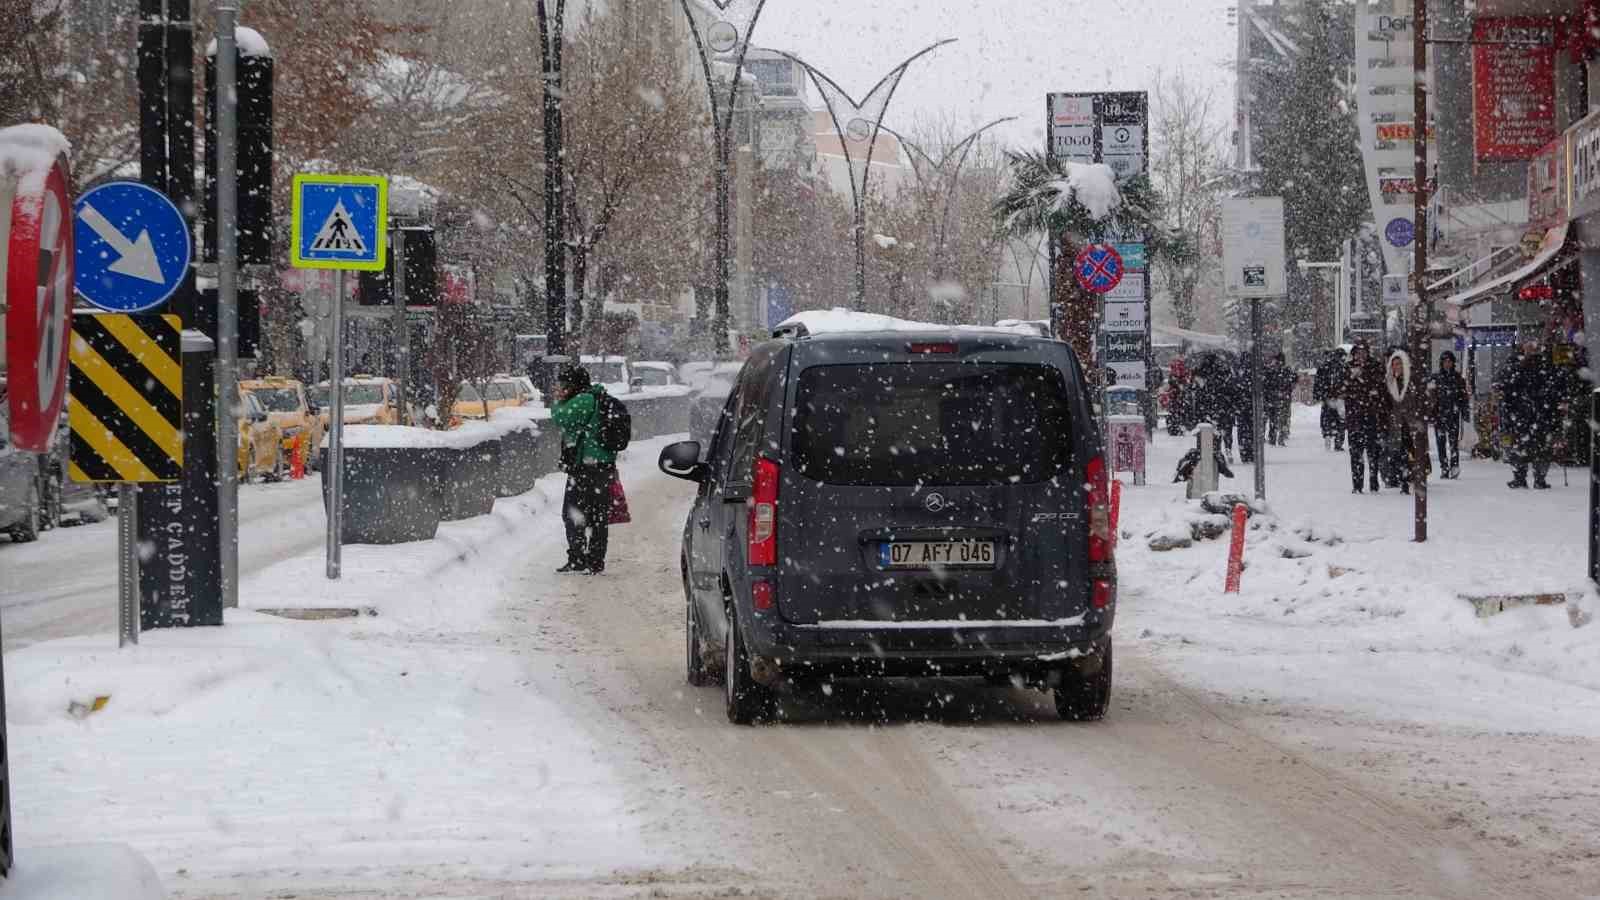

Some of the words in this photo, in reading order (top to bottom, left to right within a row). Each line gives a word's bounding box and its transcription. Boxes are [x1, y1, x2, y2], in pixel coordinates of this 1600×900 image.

[1056, 135, 1091, 146] TOGO
[891, 543, 912, 562] 07
[922, 543, 953, 562] AFY
[960, 543, 991, 562] 046
